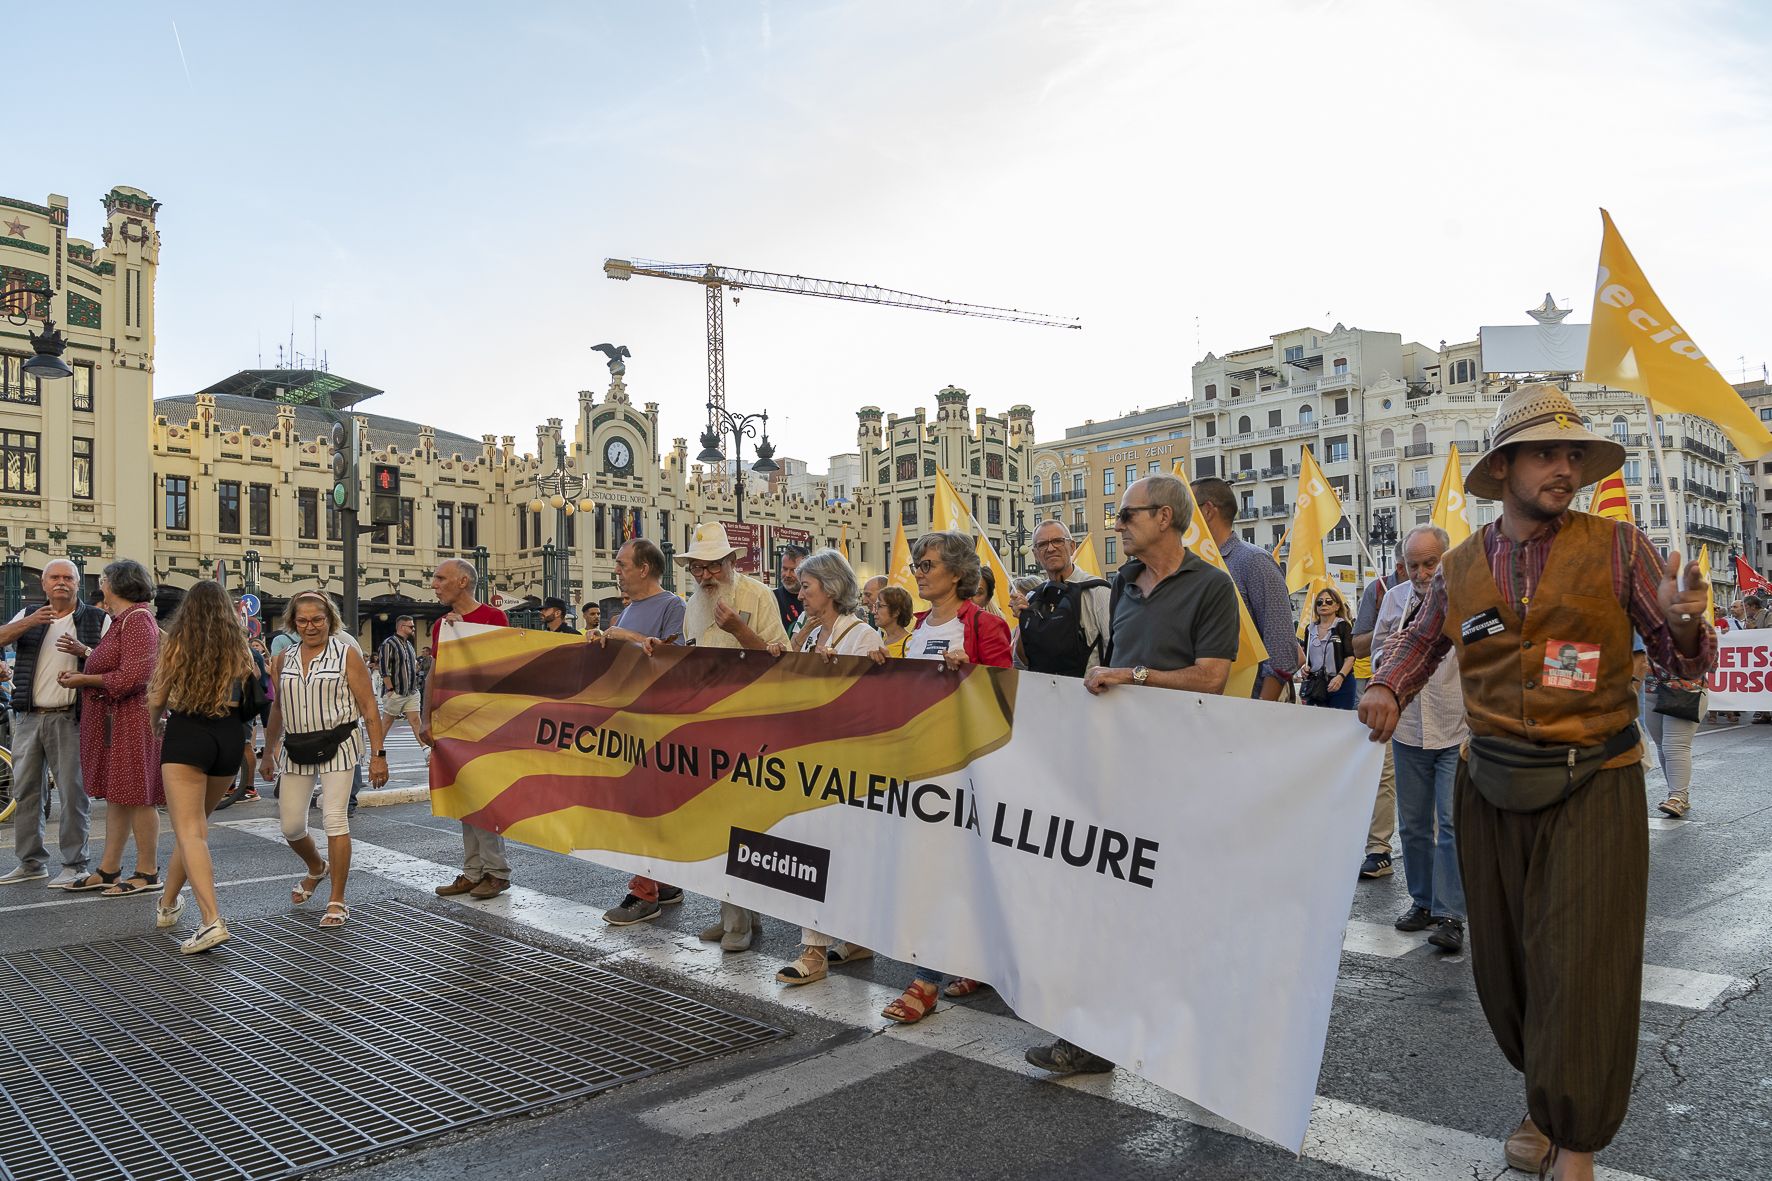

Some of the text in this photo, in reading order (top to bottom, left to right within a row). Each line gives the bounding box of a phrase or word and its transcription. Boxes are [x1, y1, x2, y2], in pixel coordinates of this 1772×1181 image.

[1108, 444, 1174, 463] HOTEL ZENIT
[1462, 617, 1501, 637] ANTIFEIXISME
[535, 717, 1160, 889] DECIDIM UN PAÍS VALENCIÀ LLIURE
[737, 843, 818, 883] Decidim
